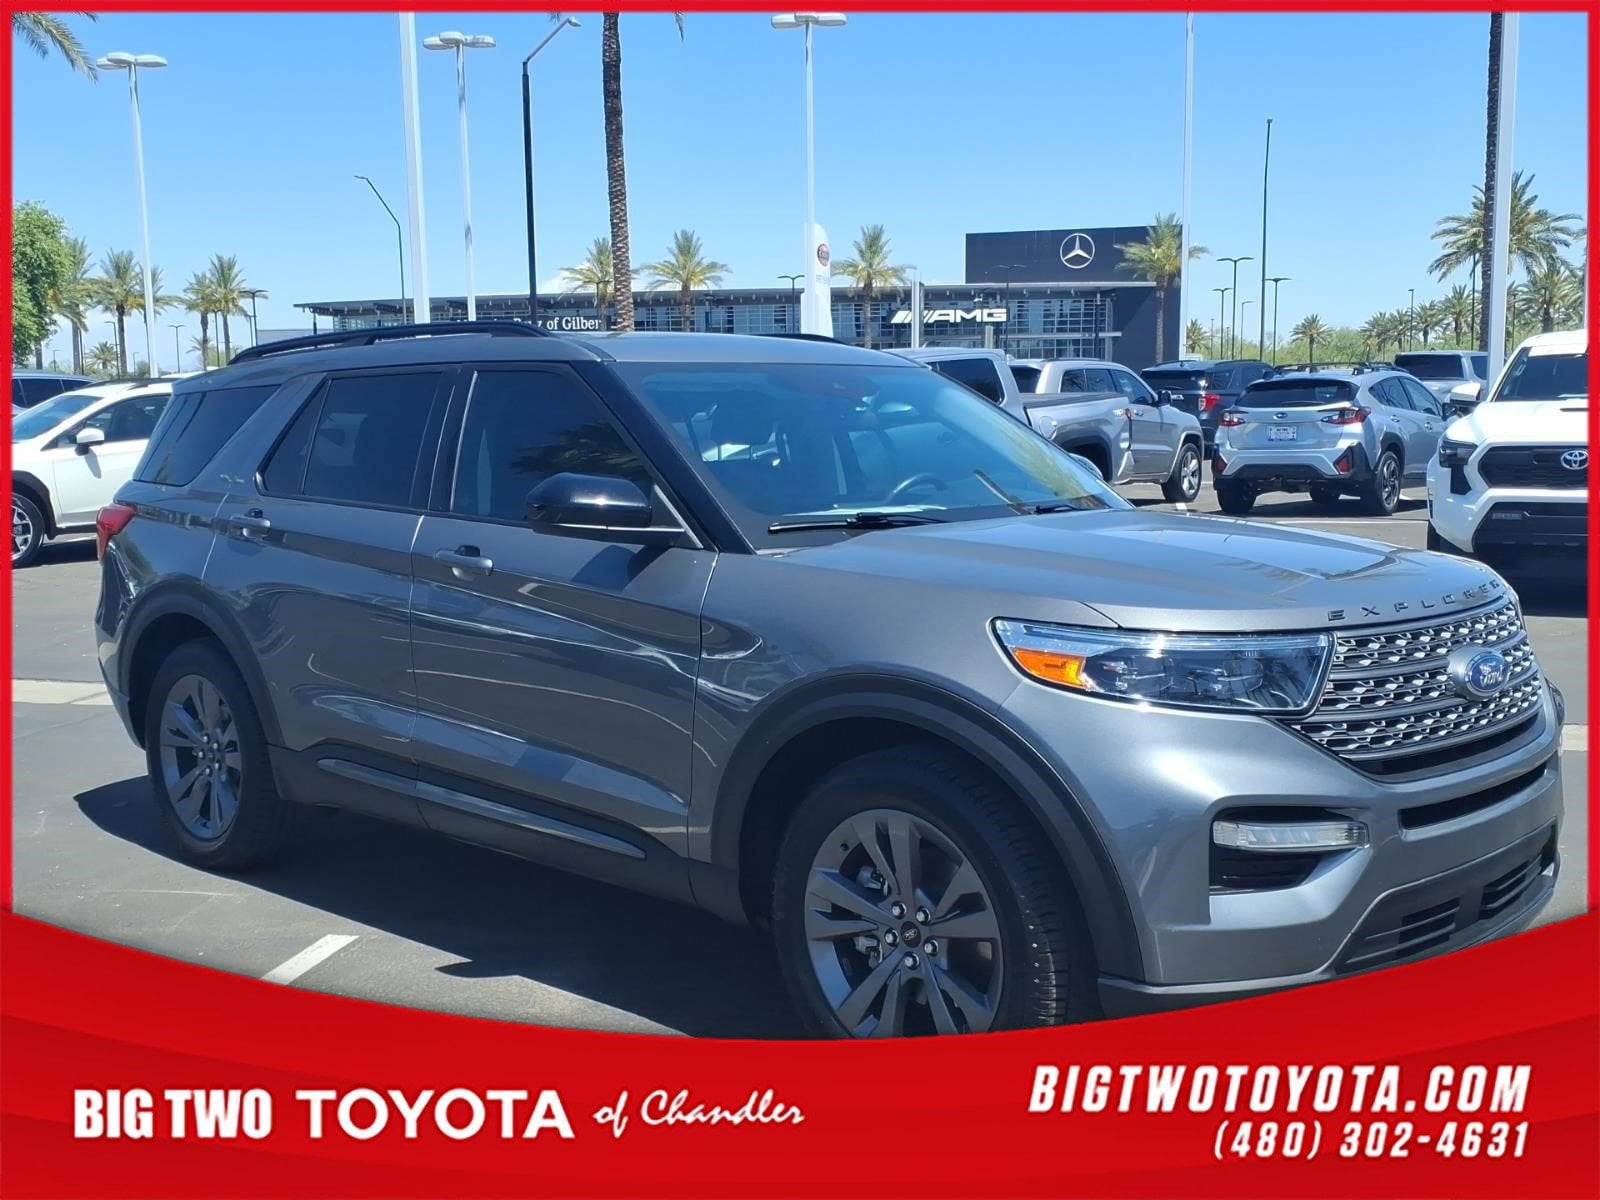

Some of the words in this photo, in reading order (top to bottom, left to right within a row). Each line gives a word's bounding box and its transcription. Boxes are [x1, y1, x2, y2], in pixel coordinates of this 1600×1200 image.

[546, 317, 560, 330] of
[562, 316, 602, 330] Gilber
[927, 308, 1007, 323] AMG
[1327, 579, 1501, 622] EXPLORER
[1479, 661, 1504, 688] Ford
